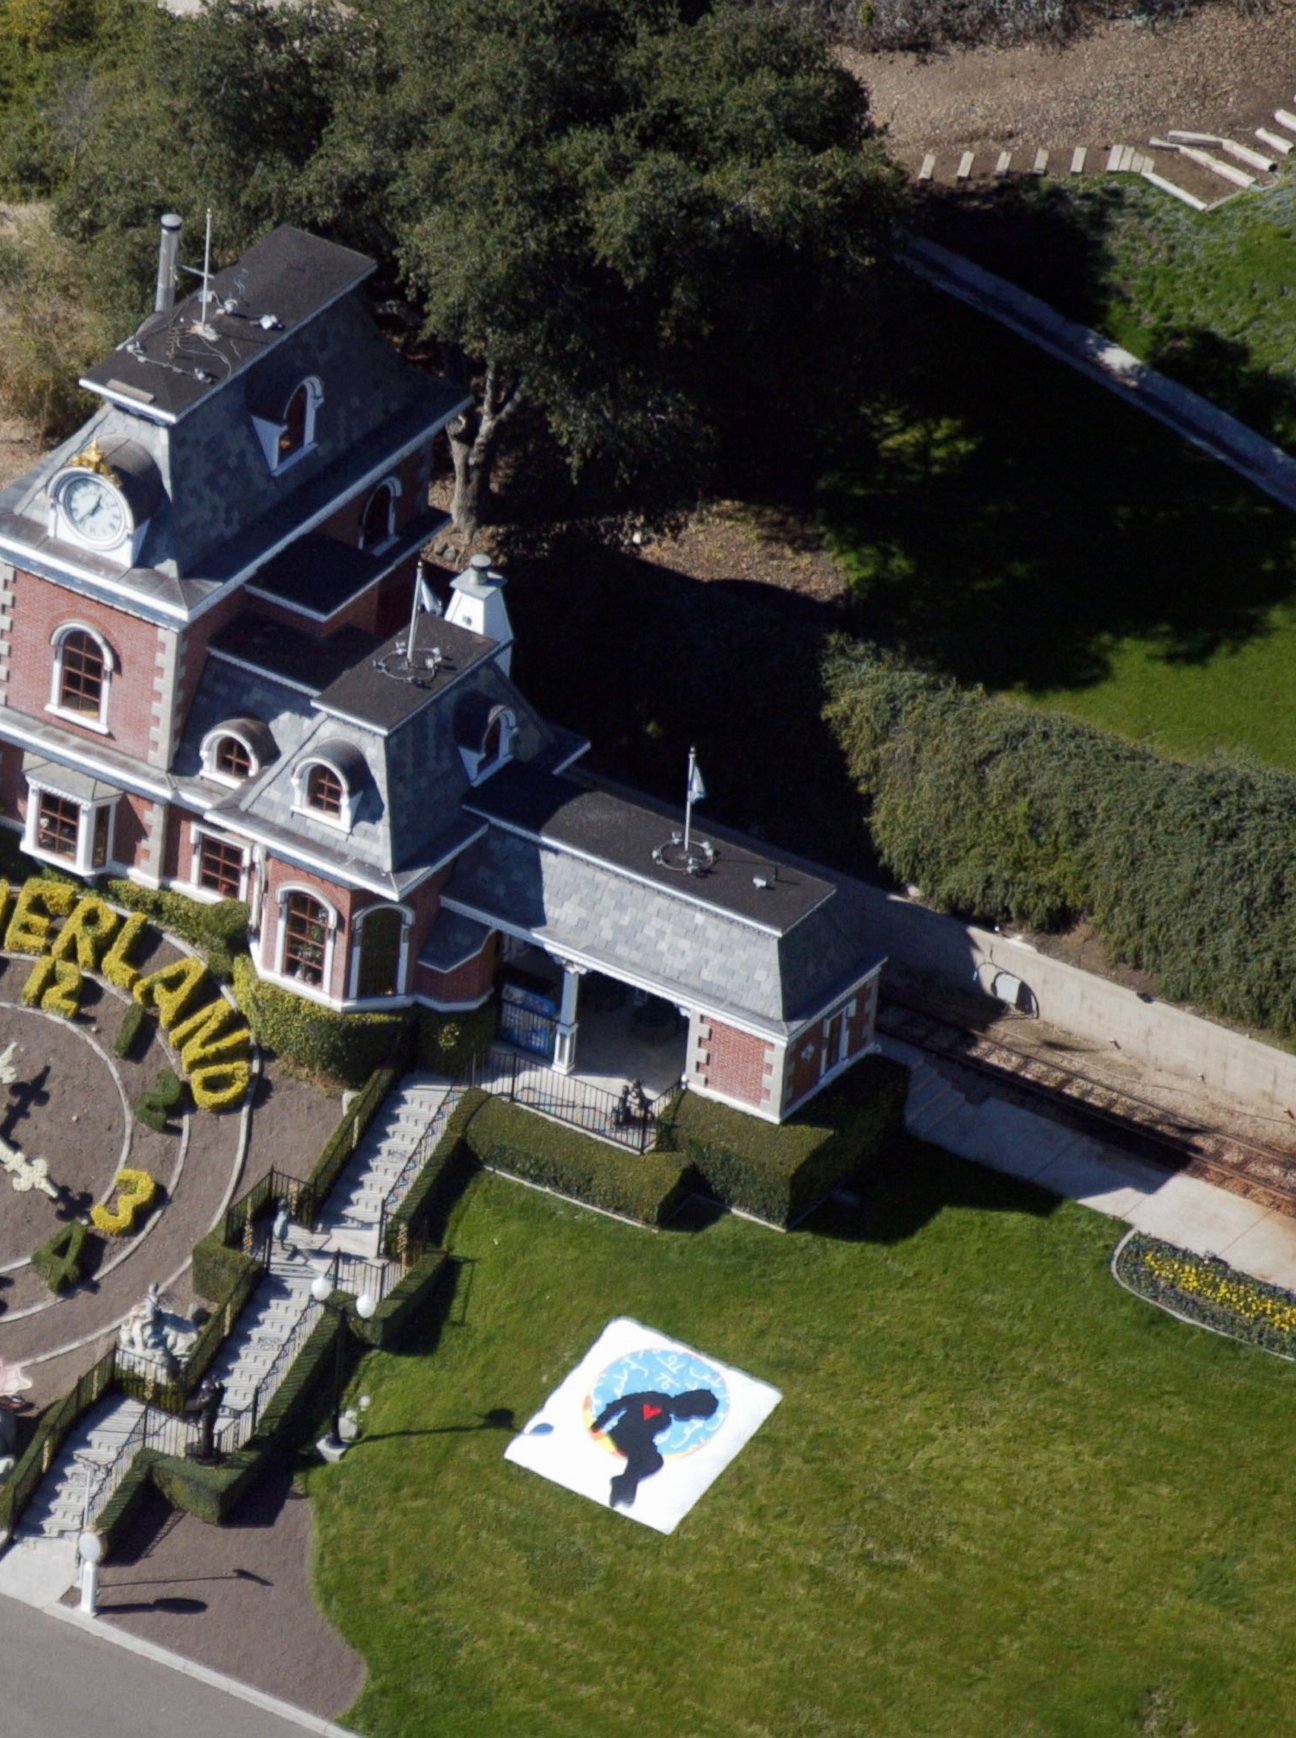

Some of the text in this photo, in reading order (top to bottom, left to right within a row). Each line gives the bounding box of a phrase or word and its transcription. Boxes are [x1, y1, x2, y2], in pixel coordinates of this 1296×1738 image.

[23, 956, 84, 1018] 12
[135, 1069, 183, 1131] 2
[91, 1168, 156, 1236] 3
[31, 1221, 88, 1294] 4
